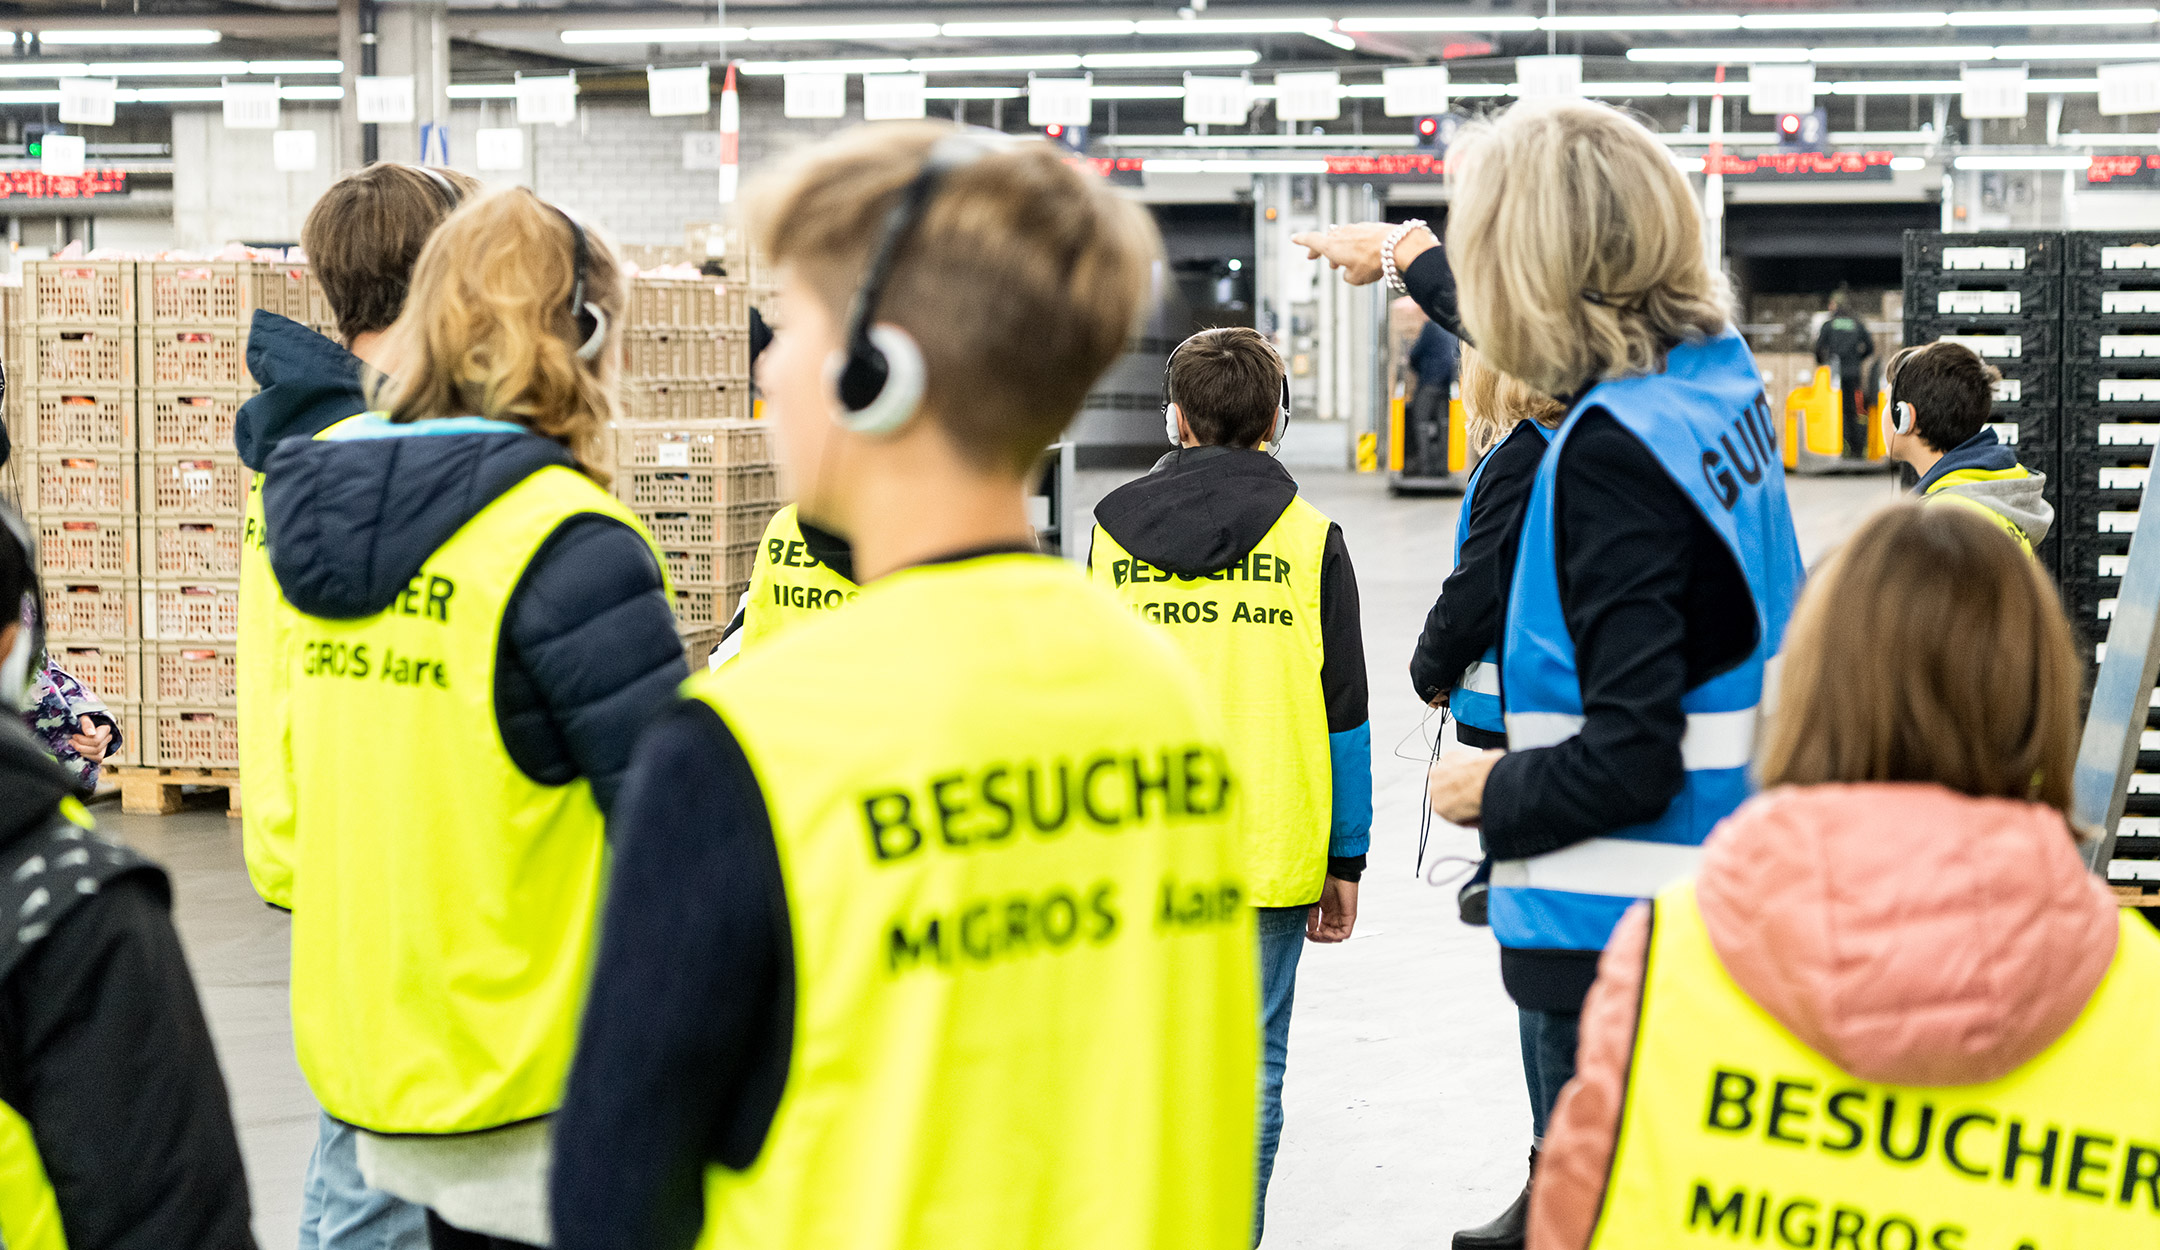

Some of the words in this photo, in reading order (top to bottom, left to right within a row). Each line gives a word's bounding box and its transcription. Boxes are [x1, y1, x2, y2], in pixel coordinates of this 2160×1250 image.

[1112, 553, 1292, 588] BEHER
[1127, 600, 1219, 625] GROS
[1232, 601, 1293, 626] Aare
[1706, 1070, 2160, 1210] BESUCHER
